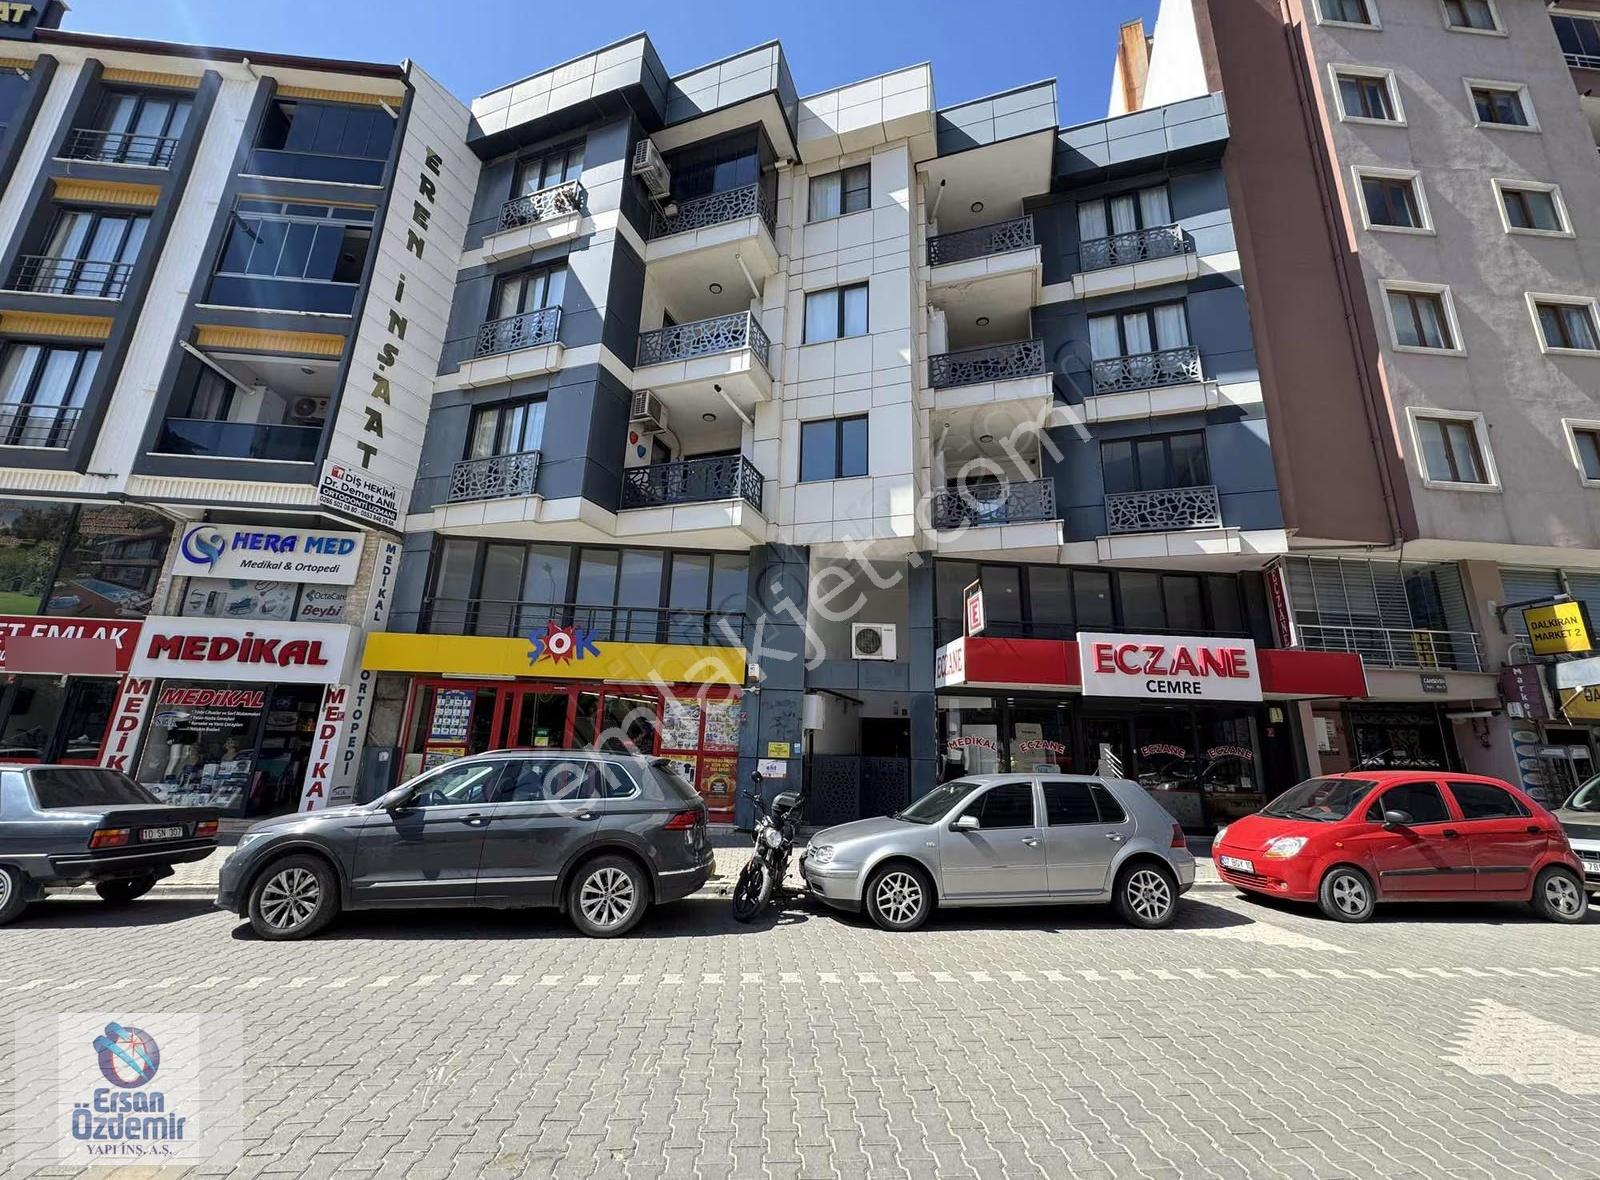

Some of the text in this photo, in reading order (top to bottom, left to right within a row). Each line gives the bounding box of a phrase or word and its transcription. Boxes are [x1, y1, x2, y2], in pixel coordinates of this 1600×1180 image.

[356, 144, 443, 470] EREN İNŞAAT
[324, 476, 397, 511] Dr. Demet ANIL
[345, 473, 396, 500] DİŞ HEKİMİ
[368, 503, 396, 519] UZMANI
[231, 532, 356, 555] HERA MED
[239, 559, 340, 574] Medikal & Ortopedi
[373, 543, 398, 622] MEDİKAL
[301, 604, 342, 618] Beybi
[1531, 616, 1578, 631] DALKIRAN
[1534, 628, 1582, 642] MARKET 2
[146, 631, 329, 667] MEDİKAL
[527, 624, 602, 667] ŞOK
[936, 647, 962, 679] ECZANE
[1091, 642, 1250, 679] ECZANE
[1145, 680, 1202, 695] CEMRE
[159, 687, 265, 708] MEDİKAL
[946, 735, 998, 752] MEDİKAL
[1019, 739, 1067, 755] ECZANE
[1140, 743, 1186, 759] ECZANE
[1207, 745, 1253, 761] ECZANE
